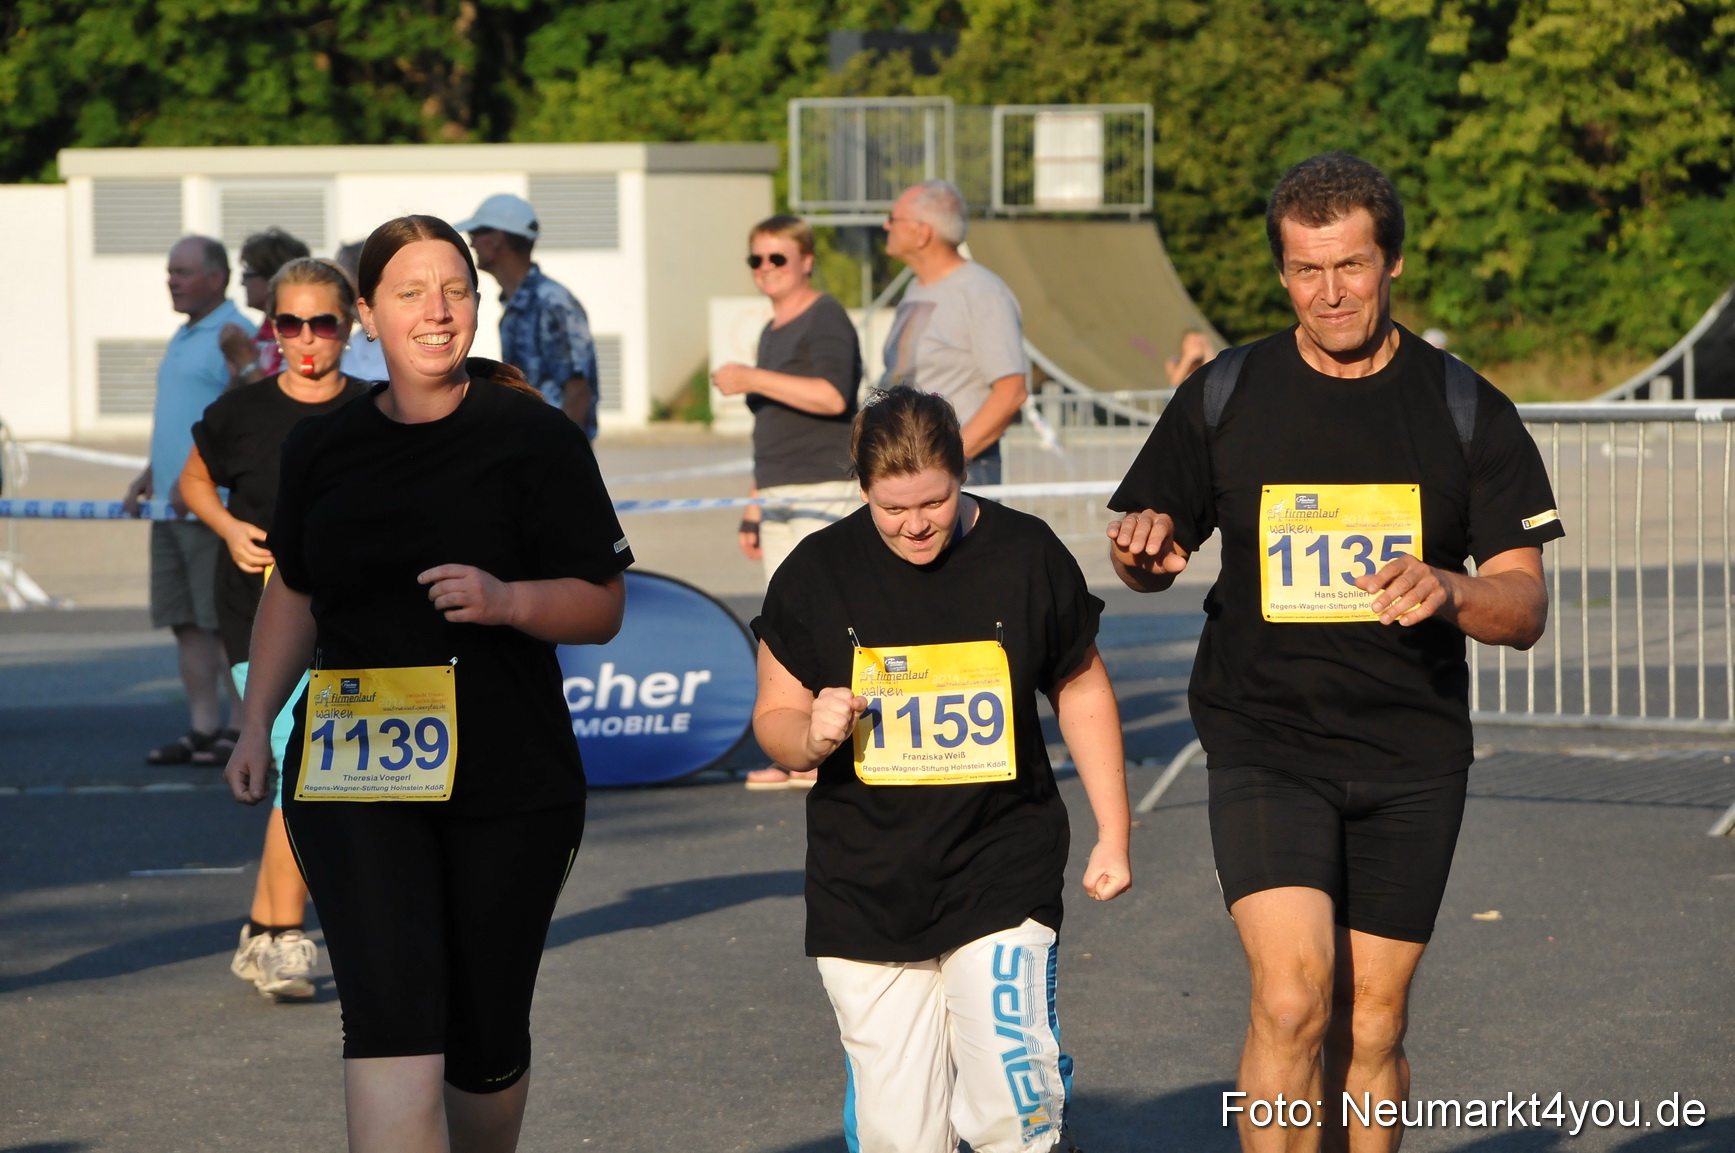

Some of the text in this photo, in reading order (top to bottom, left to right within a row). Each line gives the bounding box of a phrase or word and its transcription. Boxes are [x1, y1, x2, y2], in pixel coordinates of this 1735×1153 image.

[1285, 508, 1340, 519] firmenlauf
[1269, 523, 1313, 534] walken
[1268, 535, 1412, 586] 1135
[1270, 602, 1357, 610] Regens-Wagner-Stiftung
[877, 669, 929, 682] firmenlauf
[563, 662, 712, 712] cher
[861, 686, 903, 697] walken
[331, 691, 376, 704] firmenlauf
[316, 707, 353, 719] walken
[573, 712, 691, 738] MOBILE
[858, 691, 1005, 749] 1159
[311, 717, 449, 771] 1139
[902, 751, 966, 760] Franziska Weiß
[863, 760, 1007, 772] Regens-Wagner-Stiftung Holnstein KdöR
[343, 774, 411, 782] Theresia Voegerl
[304, 784, 388, 792] Regens-Wagner-Stiftung
